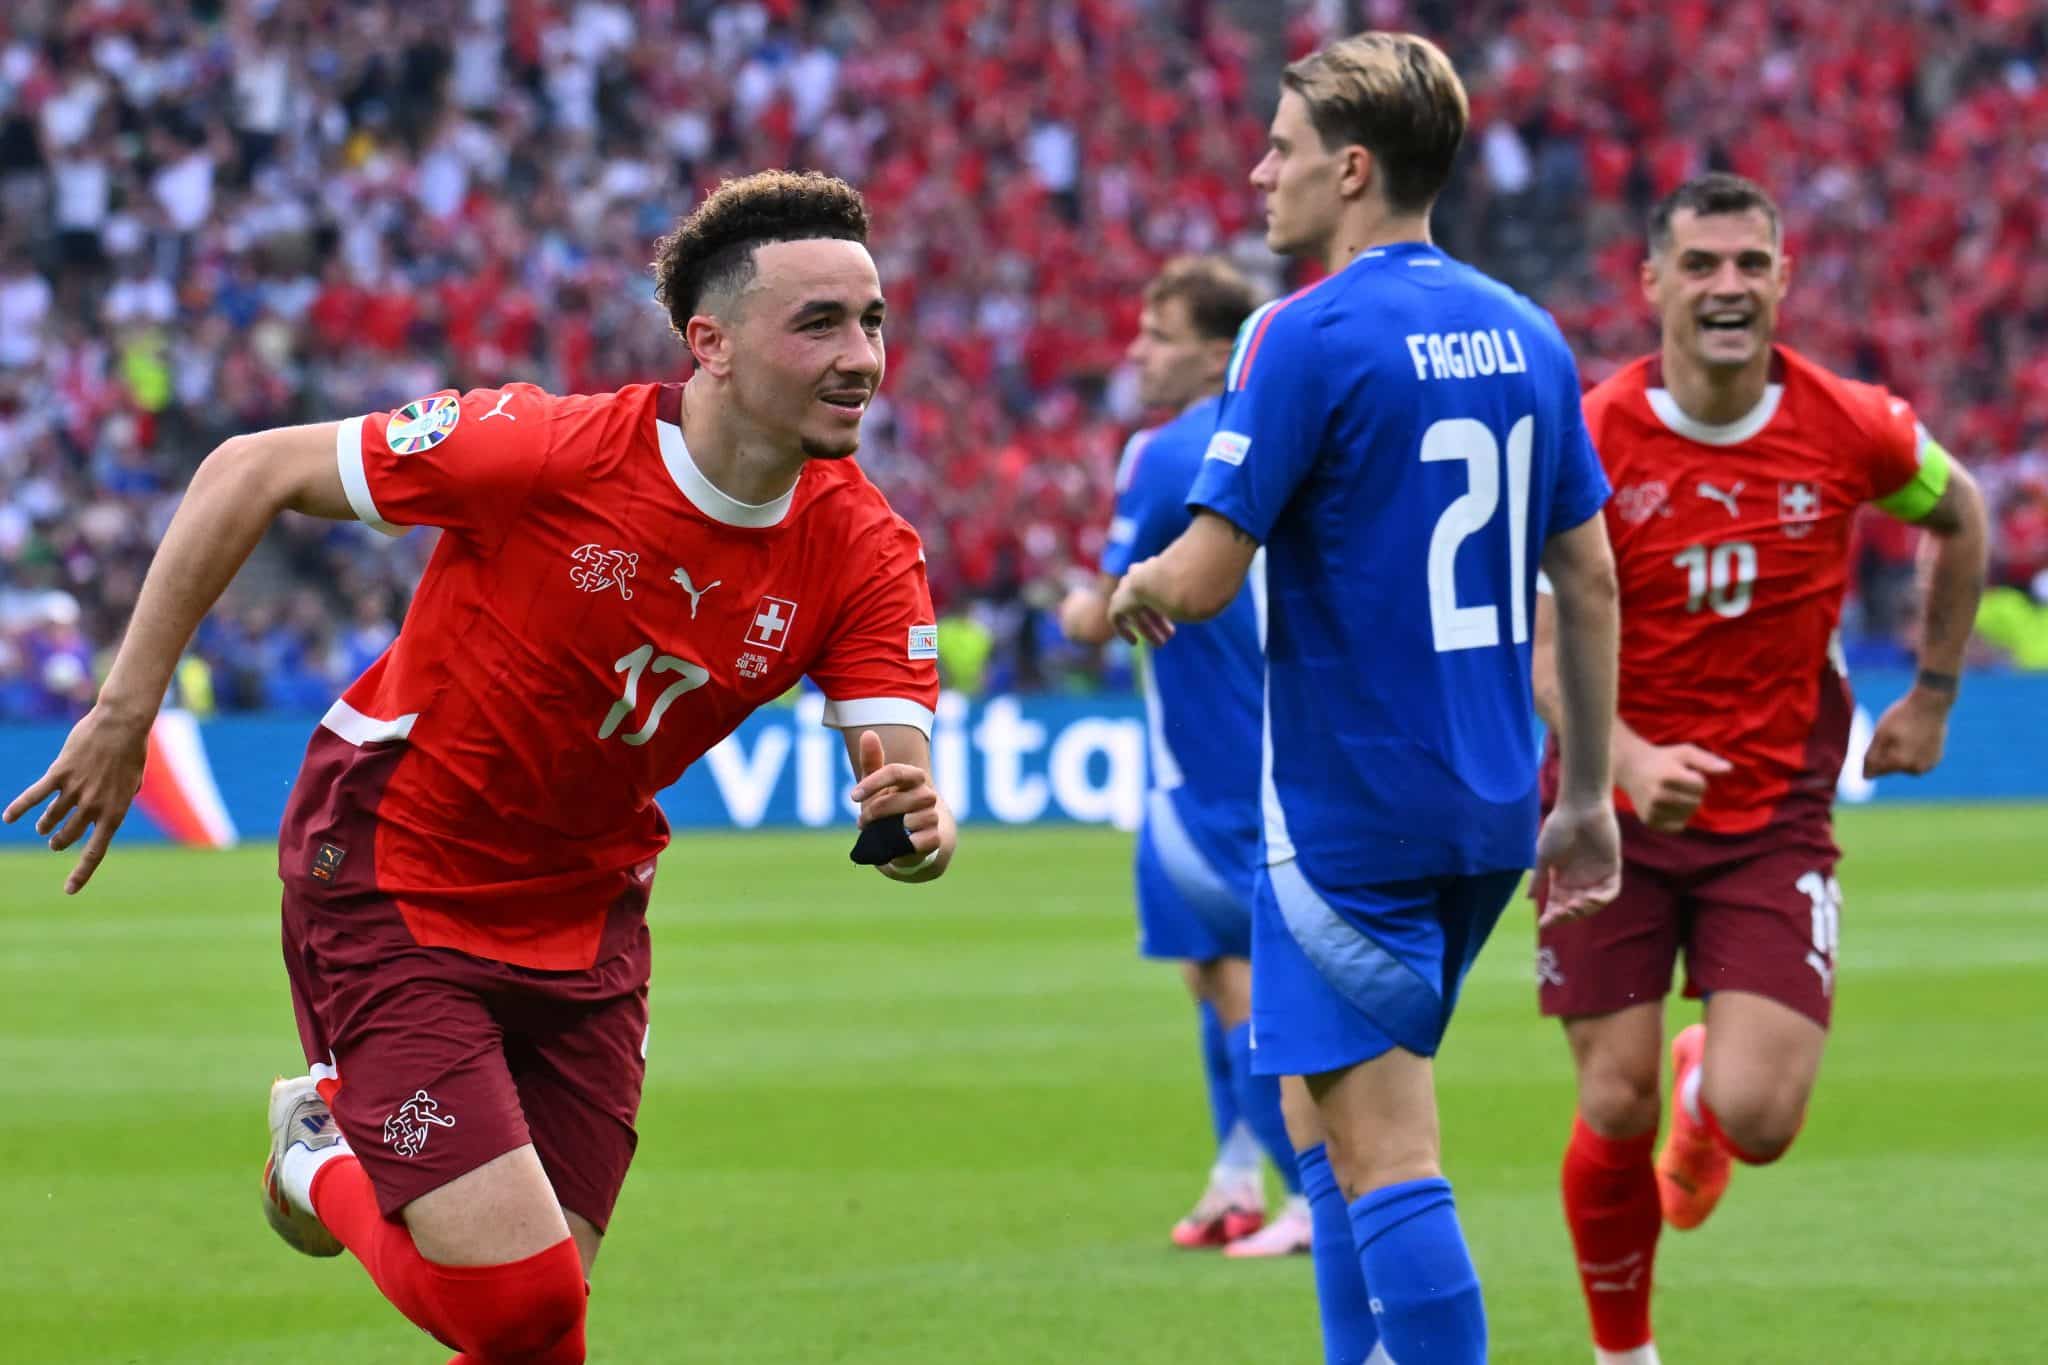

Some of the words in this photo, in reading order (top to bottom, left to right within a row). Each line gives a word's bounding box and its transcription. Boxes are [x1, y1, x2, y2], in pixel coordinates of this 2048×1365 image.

[1406, 329, 1527, 381] FAGIOLI
[1419, 413, 1535, 654] 21
[1672, 542, 1758, 618] 10
[597, 643, 710, 746] 17
